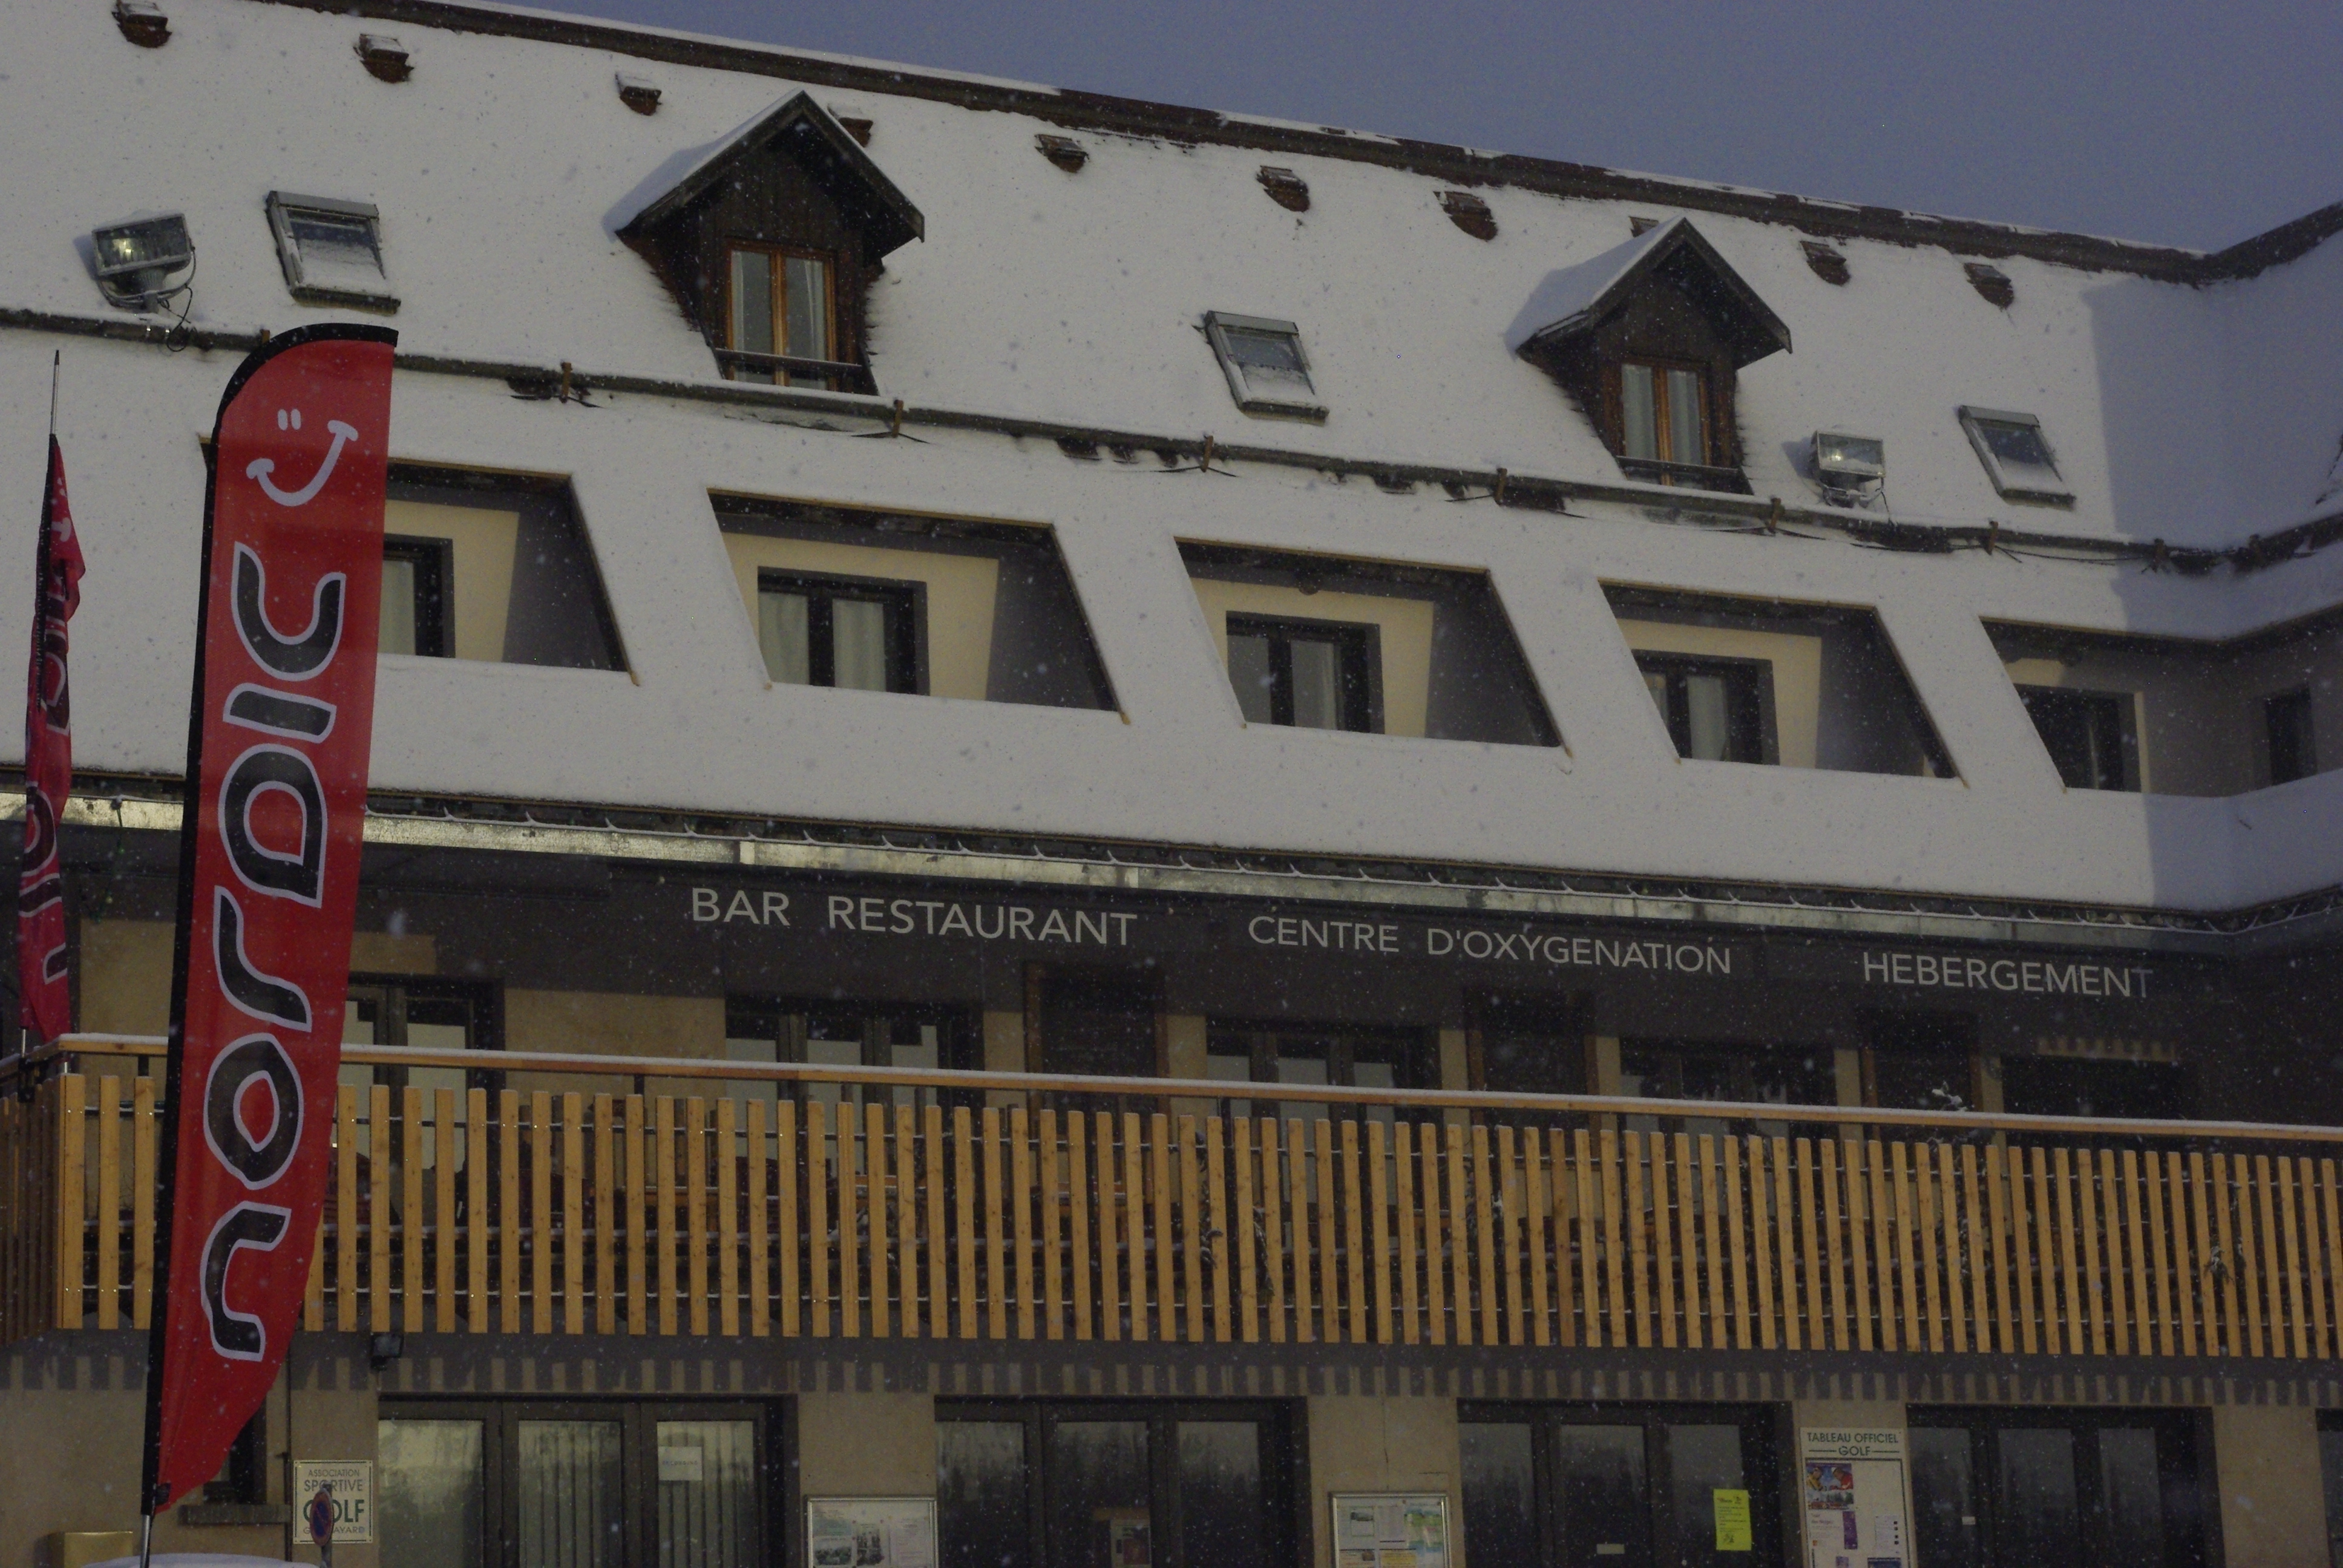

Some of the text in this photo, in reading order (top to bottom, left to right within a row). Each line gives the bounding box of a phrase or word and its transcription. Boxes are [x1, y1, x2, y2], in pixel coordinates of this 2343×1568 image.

[691, 887, 1138, 946] BAR RESTAURANT
[1248, 916, 1732, 974] CENTRE D'OXYGENATION
[1863, 952, 2154, 998] HEBERGEMENT
[1807, 1432, 1899, 1443] TABLEAU OFFICIEL
[1838, 1446, 1870, 1456] GOLF
